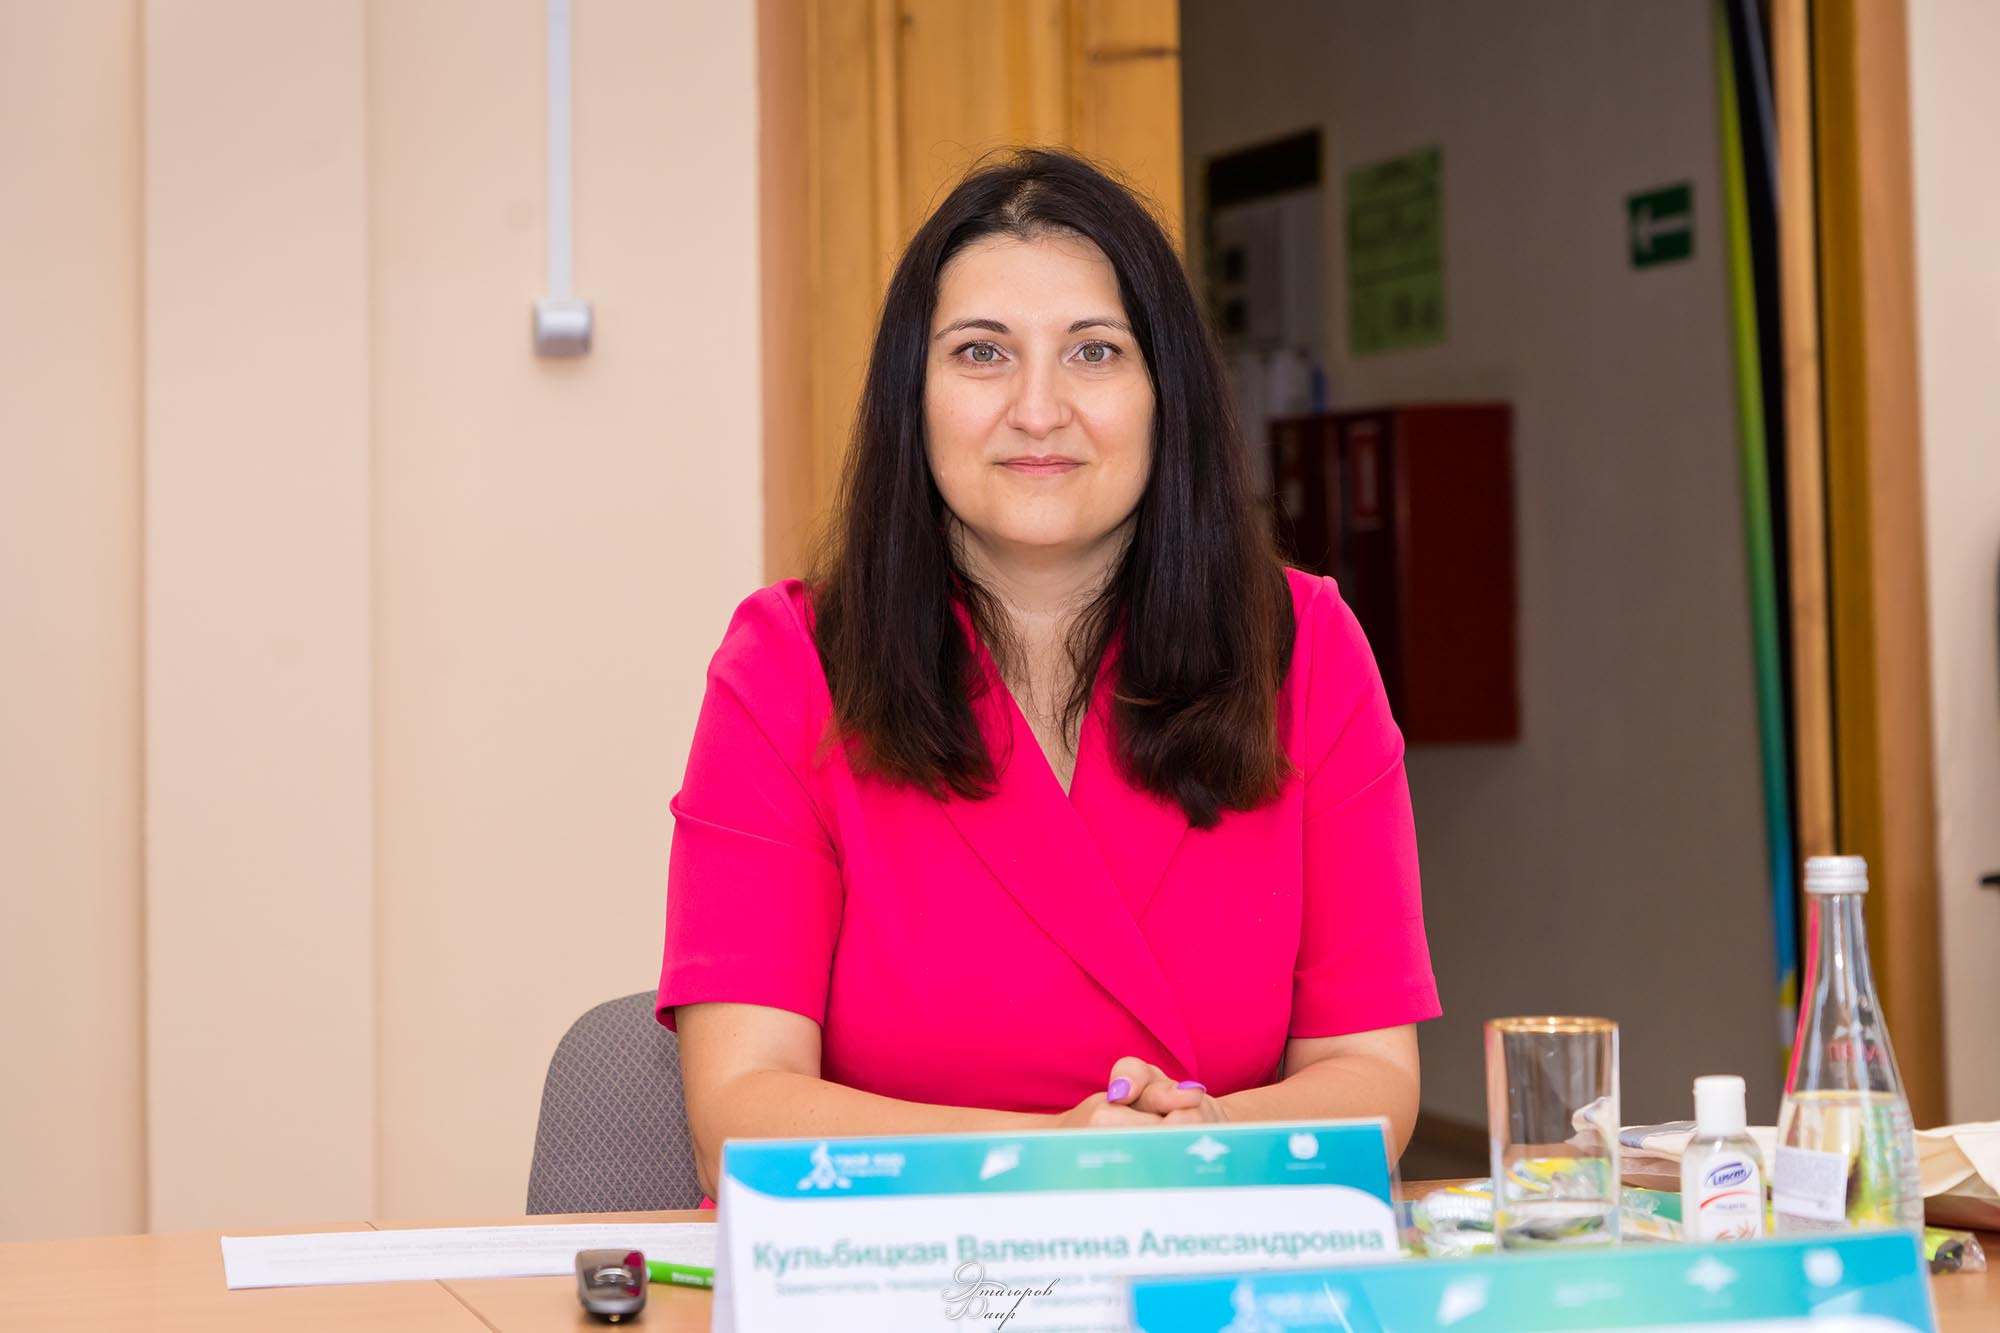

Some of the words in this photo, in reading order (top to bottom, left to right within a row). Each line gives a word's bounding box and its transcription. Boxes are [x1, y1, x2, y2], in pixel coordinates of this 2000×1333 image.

[752, 1239, 948, 1276] Кульбицкая
[956, 1231, 1127, 1262] Валентина
[1139, 1228, 1384, 1258] Александровна
